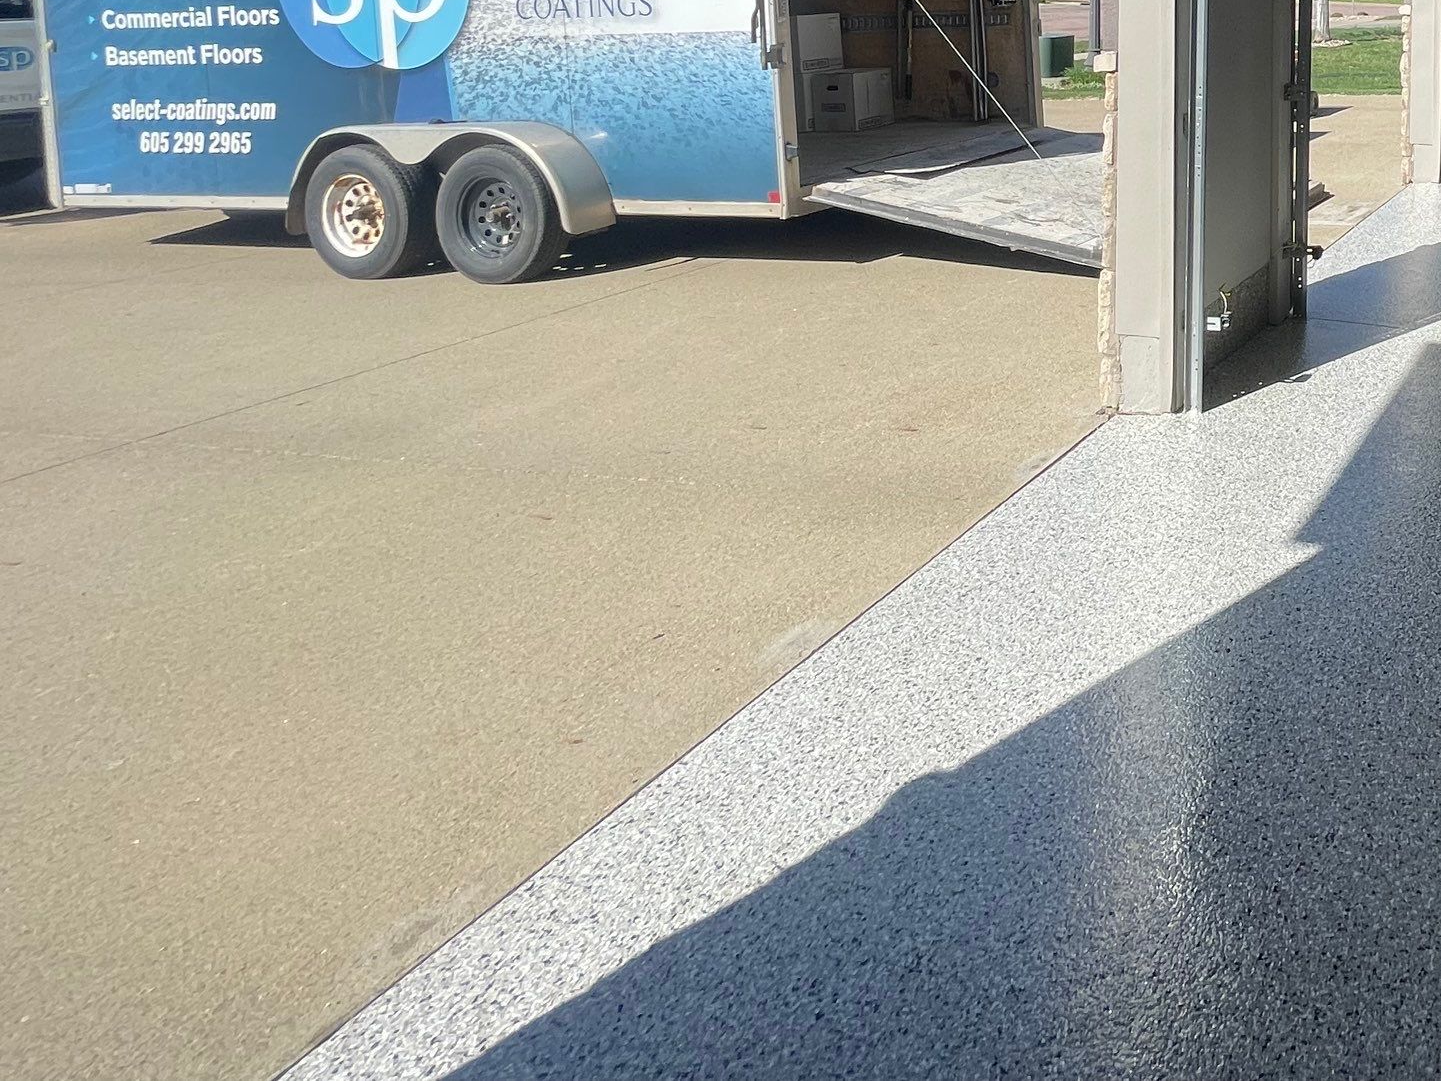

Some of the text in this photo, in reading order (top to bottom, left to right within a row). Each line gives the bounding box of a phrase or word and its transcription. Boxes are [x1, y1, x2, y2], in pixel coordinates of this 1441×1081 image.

[101, 5, 281, 30] Commercial Floors
[104, 43, 264, 66] Basement Floors
[111, 98, 277, 125] select-coatings.com
[140, 131, 253, 155] 605 299 2965
